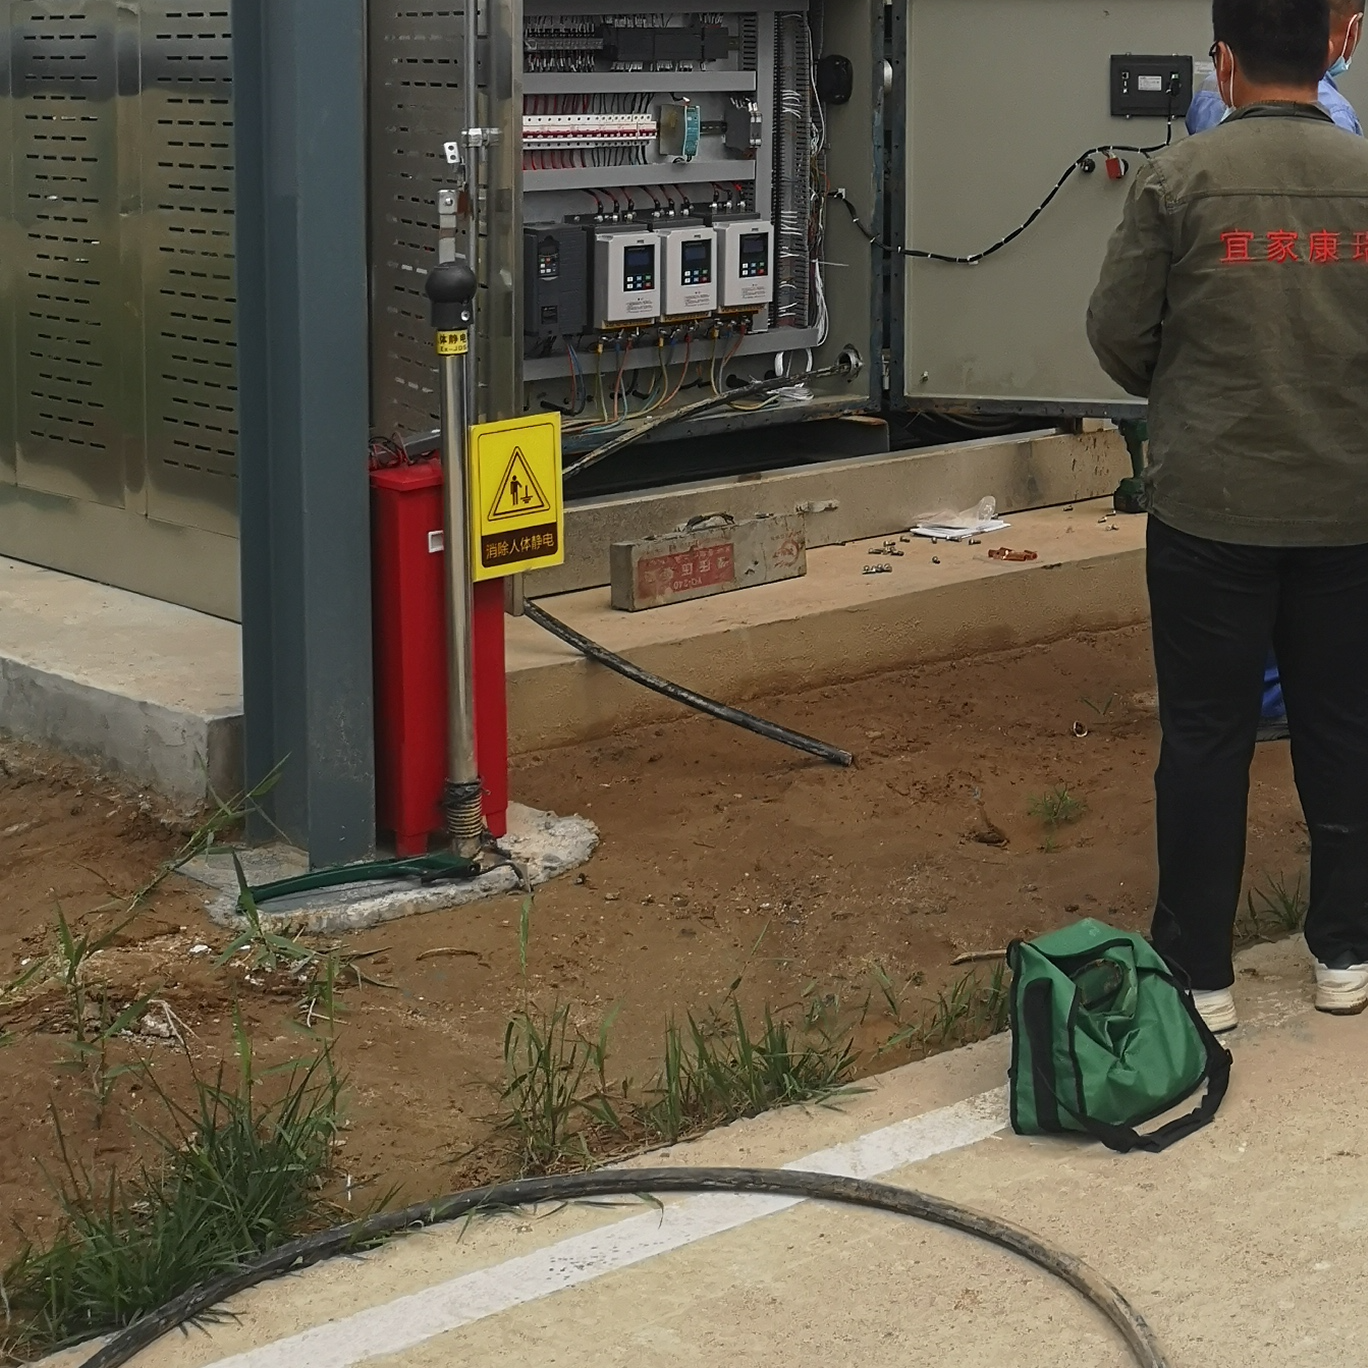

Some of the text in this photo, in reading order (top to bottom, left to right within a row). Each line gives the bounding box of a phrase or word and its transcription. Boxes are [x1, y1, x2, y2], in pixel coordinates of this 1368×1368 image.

[485, 533, 555, 560] 消除人体静电
